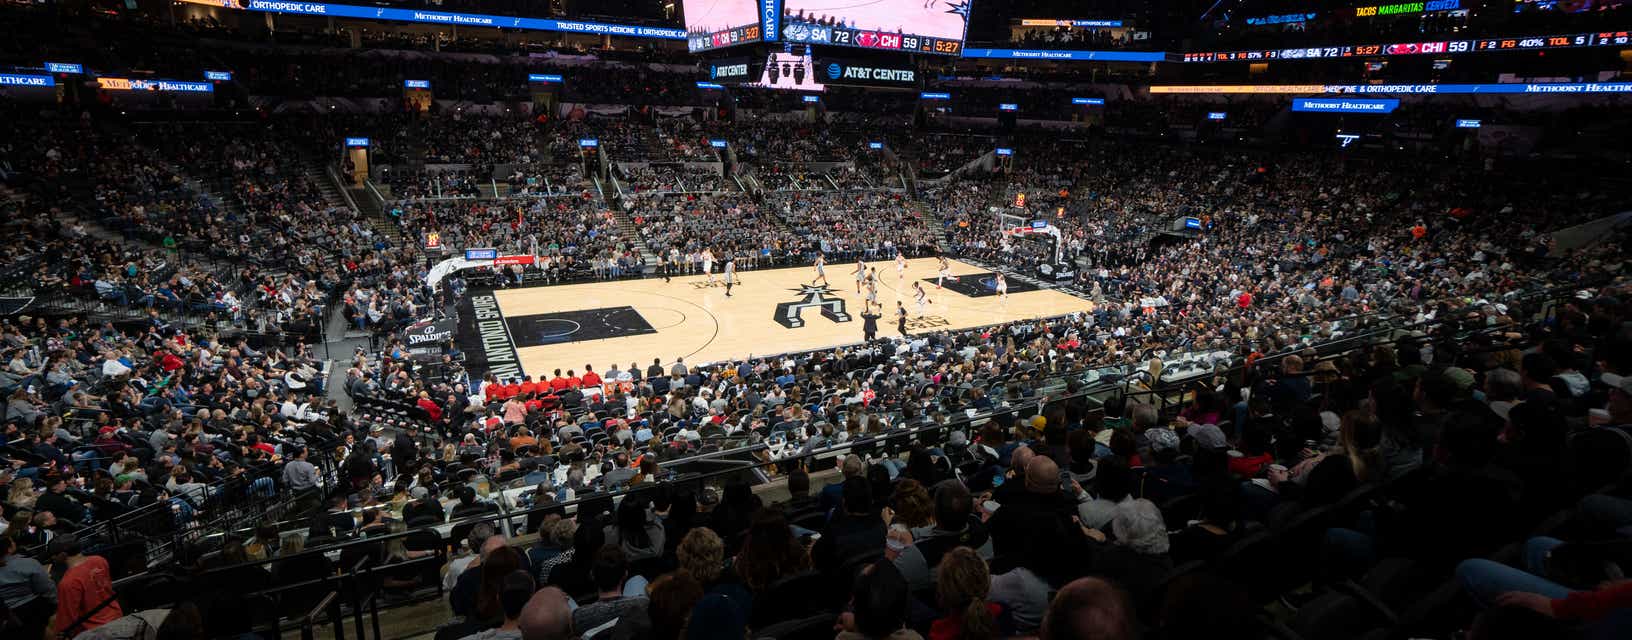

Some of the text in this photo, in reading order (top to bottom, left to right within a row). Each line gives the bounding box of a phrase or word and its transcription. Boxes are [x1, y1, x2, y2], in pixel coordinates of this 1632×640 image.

[253, 1, 303, 12] ORTHOPEDIC
[305, 4, 326, 13] CARE
[1356, 6, 1377, 17] TACOS
[1378, 2, 1424, 15] MARGARITAS
[415, 12, 493, 24] METHODIST HEALTHCARE
[556, 22, 584, 31] TRUSTED
[585, 24, 609, 33] SPORTS
[644, 28, 677, 37] ORTHOPEDIC
[811, 28, 959, 53] SA 72 CHI 59 3 5:27
[1307, 48, 1321, 57] SA
[1323, 47, 1338, 57] 72
[1355, 45, 1379, 55] 5:27
[1421, 43, 1444, 53] CHI
[1448, 41, 1468, 52] 59
[1479, 41, 1487, 49] F
[1487, 41, 1497, 49] 2
[1501, 40, 1516, 48] FG
[1518, 39, 1544, 47] 40%
[1549, 37, 1570, 46] TOL
[1575, 36, 1585, 45] 5
[728, 64, 748, 76] CENTER
[844, 66, 915, 82] AT&T CENTER
[159, 82, 208, 91] HEALTHCARE
[1359, 85, 1366, 93] &
[1366, 85, 1414, 93] ORTHOPEDIC
[1415, 85, 1437, 93] CARE
[1525, 84, 1585, 92] METHODIST
[1341, 102, 1385, 110] HEALTHCARE
[472, 295, 500, 320] SPURS
[478, 320, 515, 362] ANTONIO
